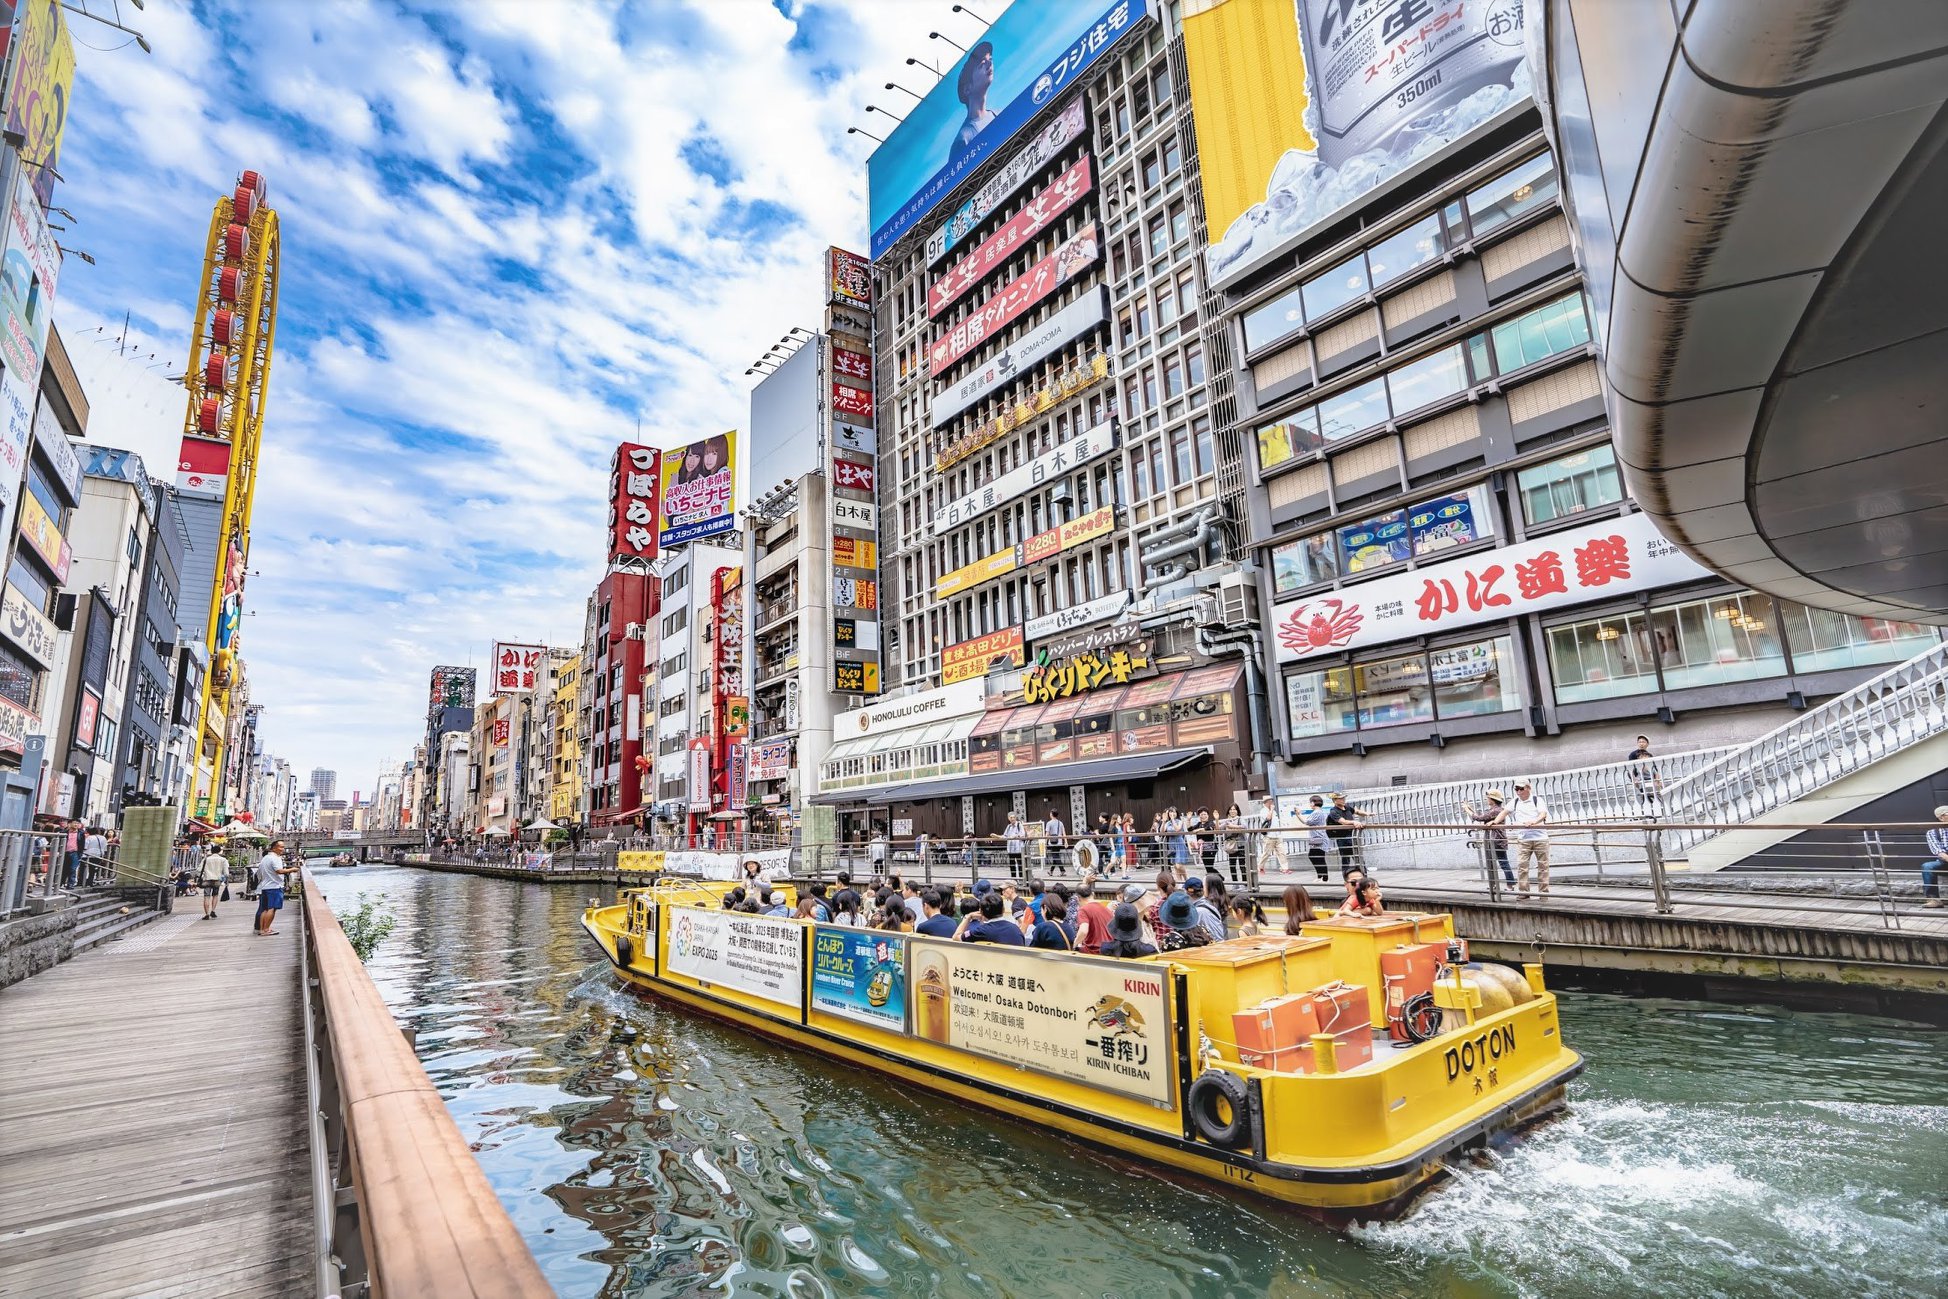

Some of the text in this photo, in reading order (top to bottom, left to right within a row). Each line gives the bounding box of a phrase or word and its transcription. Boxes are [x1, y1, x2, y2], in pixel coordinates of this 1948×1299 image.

[1052, 1, 1129, 85] フジ住宅
[1364, 3, 1464, 84] スーパードライ
[1397, 69, 1442, 109] 350ml
[992, 172, 1018, 203] 居酒屋
[928, 236, 943, 259] 9F
[932, 254, 981, 310] 笑笑
[1021, 169, 1083, 236] 笑笑
[834, 290, 846, 302] 9F
[949, 264, 1051, 357] 相席ダイニング
[1020, 326, 1063, 359] DOMA-DOMA
[834, 354, 870, 379] 笑笑
[833, 396, 873, 414] ダイニング
[838, 386, 857, 399] 相席
[841, 451, 853, 460] 5F
[665, 470, 732, 499] 高収入お仕事情報
[834, 487, 848, 496] 4F
[936, 438, 1090, 526] 4F 白木屋 白木屋
[625, 448, 658, 552] づぼらや
[665, 486, 731, 515] いちごナビ
[835, 502, 871, 521] 白木屋
[674, 513, 698, 526] いちごナビ
[835, 526, 849, 536] 3F
[835, 567, 850, 577] 2F
[836, 608, 850, 617] 1F
[1375, 600, 1403, 612] 本場の味
[1376, 608, 1404, 620] かに料理
[718, 598, 743, 697] 大阪王将
[943, 626, 1022, 665] 豊後高田どり 2F
[1049, 625, 1138, 656] ハンバーグレストラン
[837, 667, 861, 680] びっくり
[954, 658, 984, 679] 酒場
[1022, 651, 1148, 704] びっくりドンキー
[837, 678, 863, 689] ドンキー
[872, 697, 946, 723] HONOLULU COFFEE
[692, 945, 718, 961] EXPO 2025
[817, 937, 844, 955] とんぼり
[817, 953, 854, 973] リバークルーズ
[953, 966, 1046, 993] ようこそ! 大阪 道頓堀へ
[1124, 979, 1160, 996] KIRIN
[953, 985, 1077, 1021] Welcome! Osaka Dotonbori
[954, 1020, 1002, 1042] 어서오십시오!
[1004, 1033, 1031, 1050] 오사카
[1085, 1036, 1148, 1065] 一番搾り
[1444, 1022, 1517, 1083] DOTON
[1086, 1056, 1151, 1081] KIRIN ICHIBAN
[1472, 1065, 1499, 1096] 大阪
